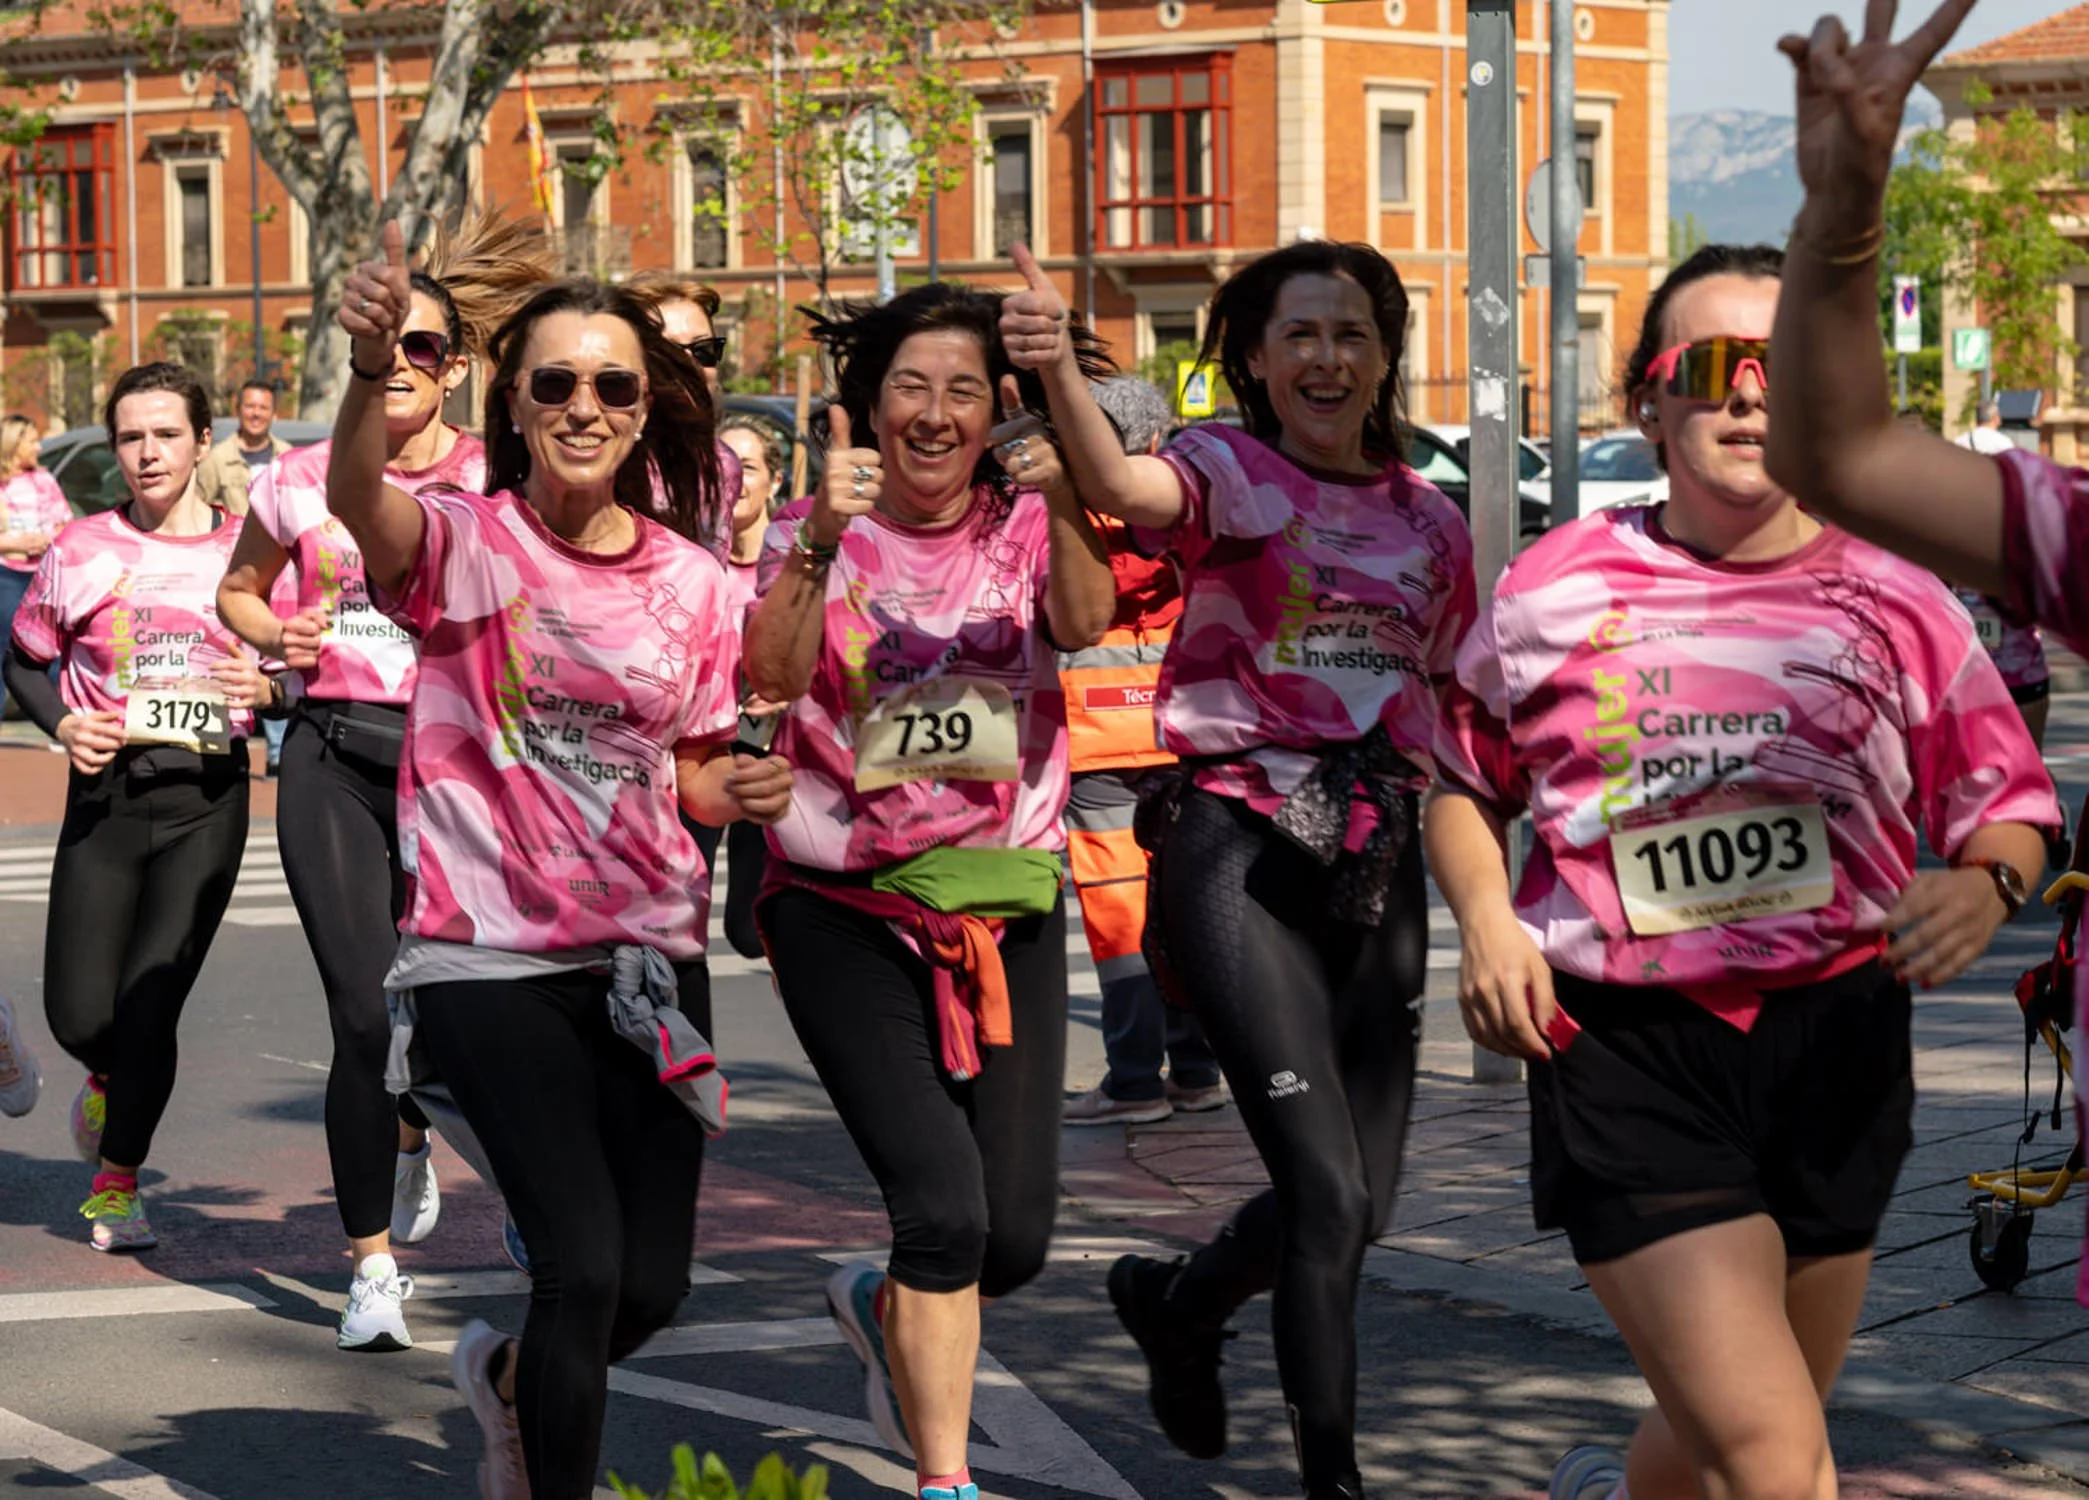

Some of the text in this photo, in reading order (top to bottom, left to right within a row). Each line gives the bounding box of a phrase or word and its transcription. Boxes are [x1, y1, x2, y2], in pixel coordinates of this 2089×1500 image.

[341, 551, 359, 569] XI
[315, 546, 340, 635] ujer
[1315, 566, 1337, 587] XI
[134, 608, 152, 625] XI
[1314, 593, 1402, 620] Carrera
[134, 630, 203, 646] Carrera
[1303, 620, 1369, 642] por la
[108, 607, 135, 689] mujer
[135, 651, 185, 670] por la
[530, 653, 555, 678] XI
[1636, 667, 1671, 697] XI
[146, 699, 211, 732] 3179
[526, 686, 620, 721] Carrera
[523, 719, 584, 744] por la
[893, 711, 973, 757] 739
[1636, 709, 1787, 738] Carrera
[1585, 669, 1640, 825] mujer
[1643, 748, 1746, 787] por la
[1634, 817, 1809, 893] 11093
